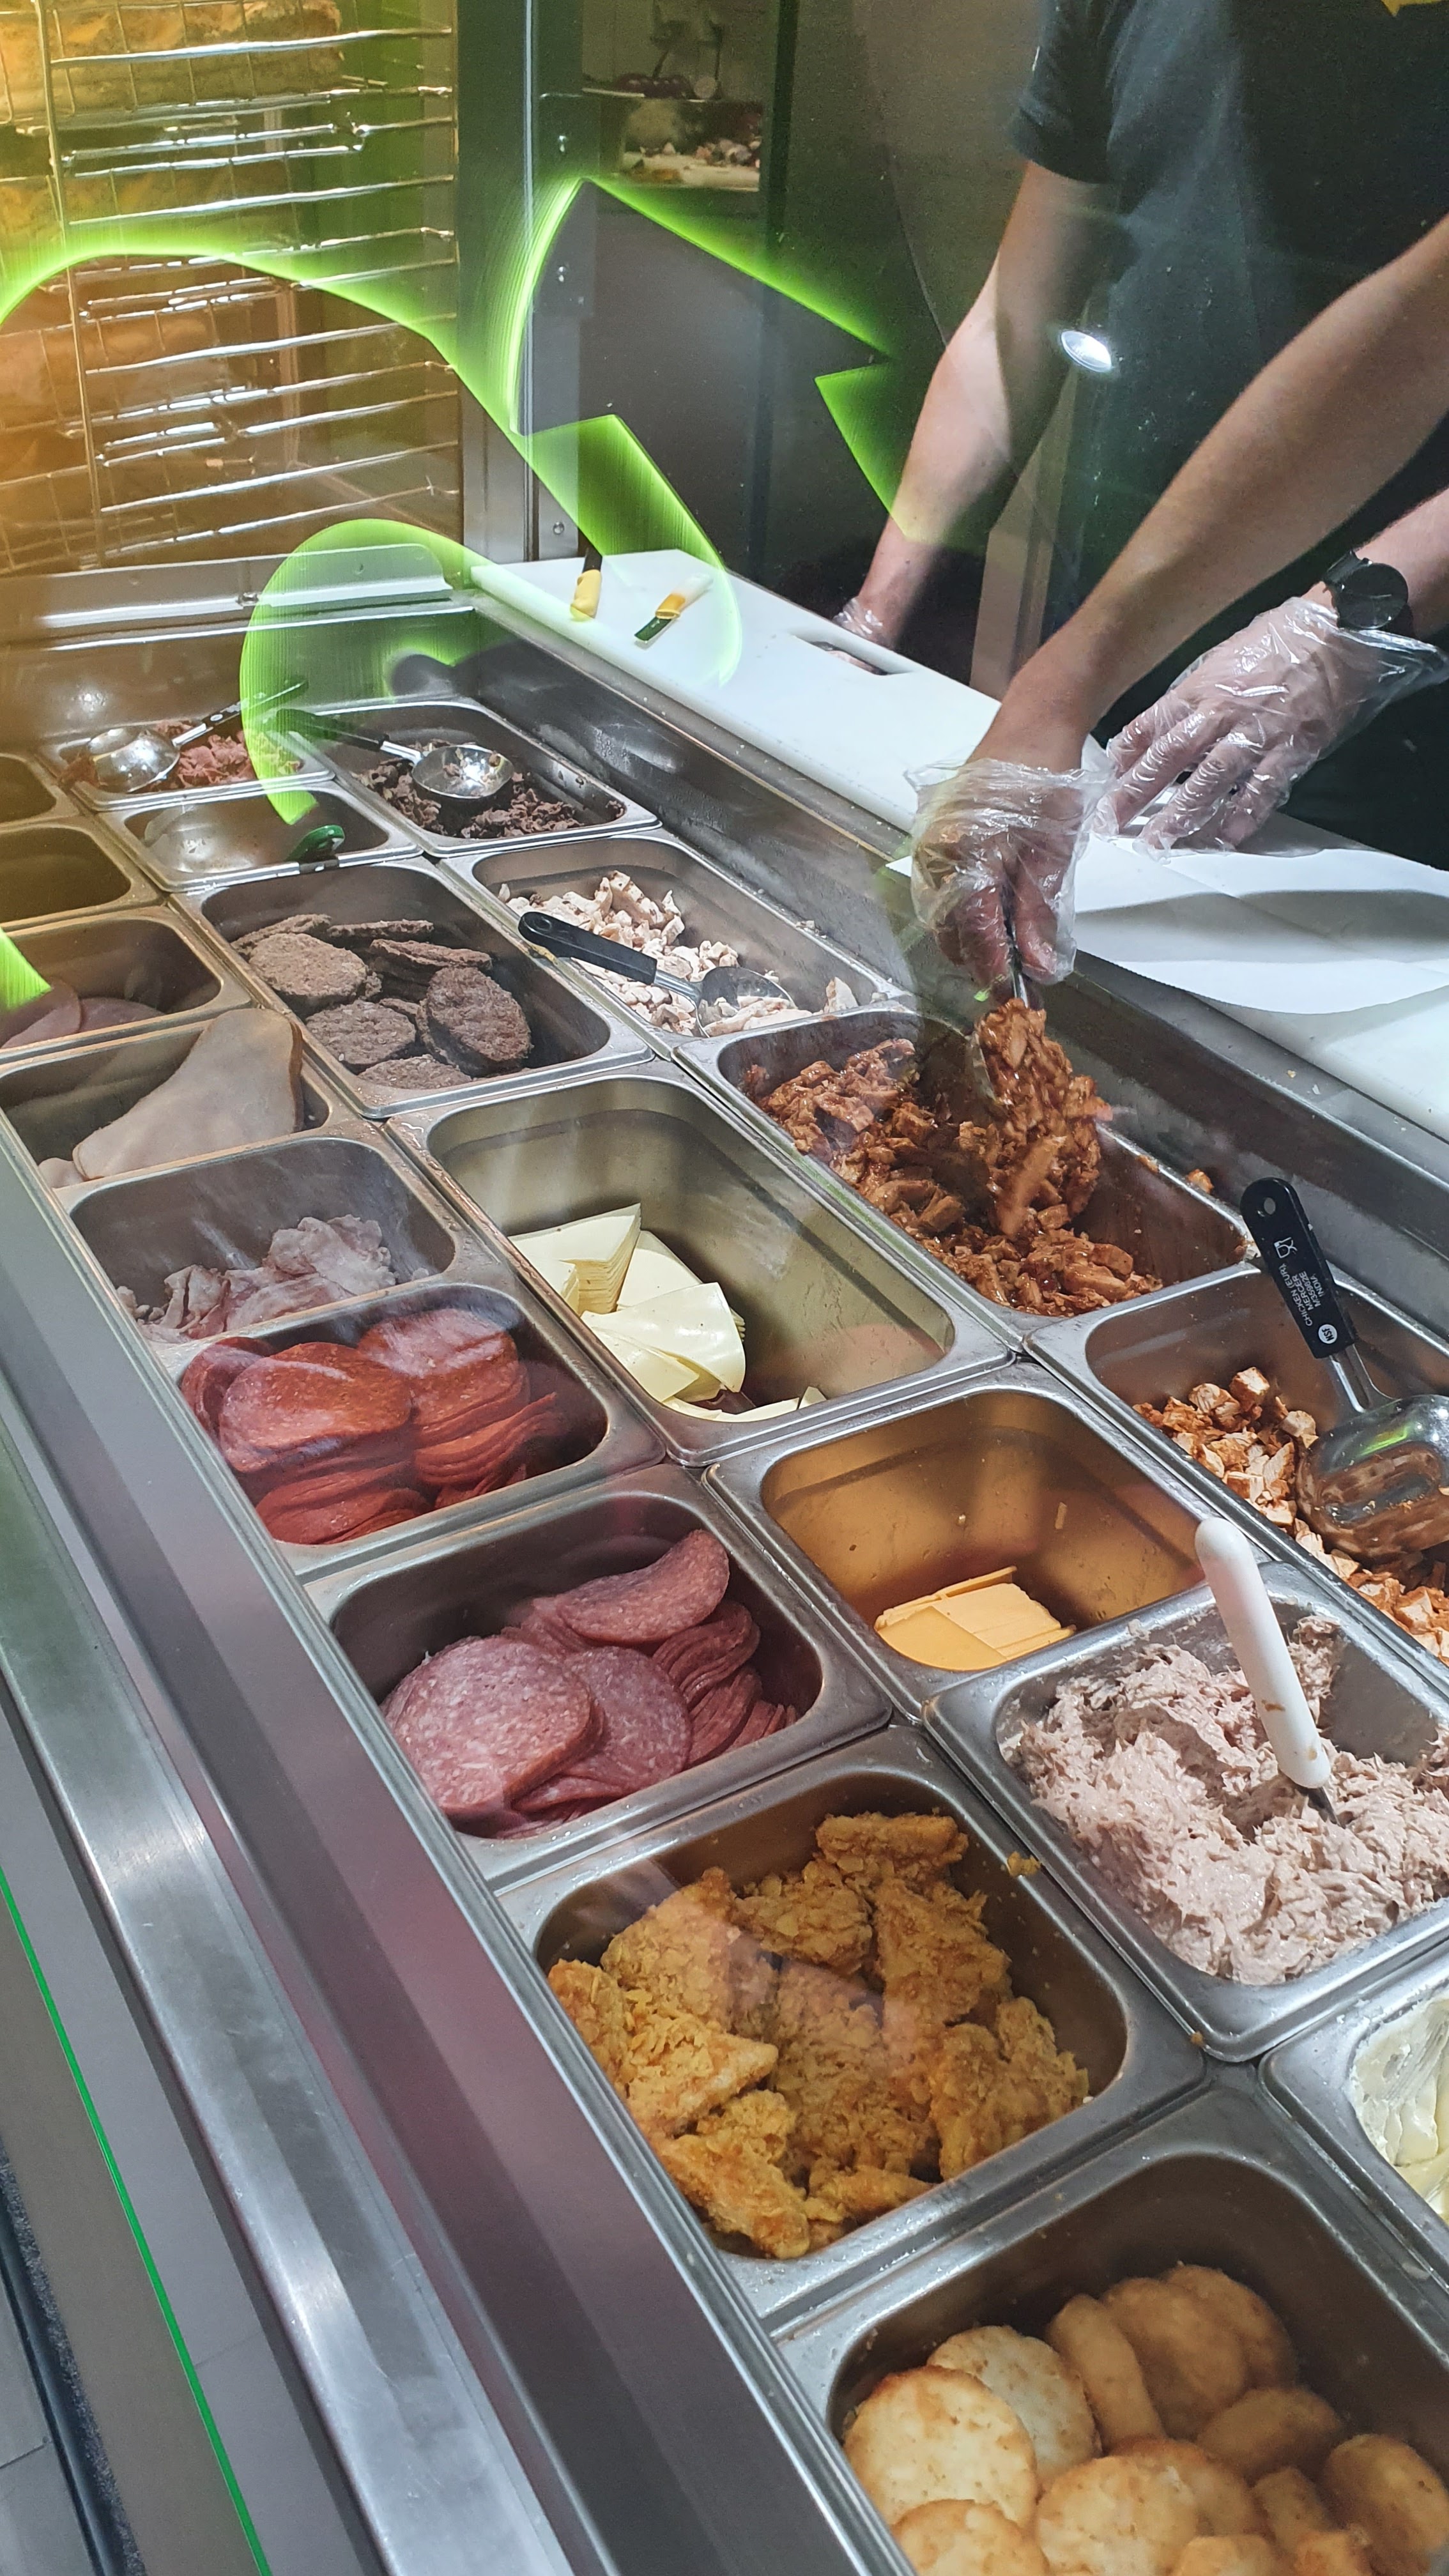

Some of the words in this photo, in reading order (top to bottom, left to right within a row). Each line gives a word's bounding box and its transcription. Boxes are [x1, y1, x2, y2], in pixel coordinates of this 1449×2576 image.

[1292, 1274, 1314, 1310] MERCER
[1310, 1273, 1324, 1297] INDIA
[1291, 1289, 1312, 1326] CHICKEN
[1321, 1328, 1334, 1341] NSF
